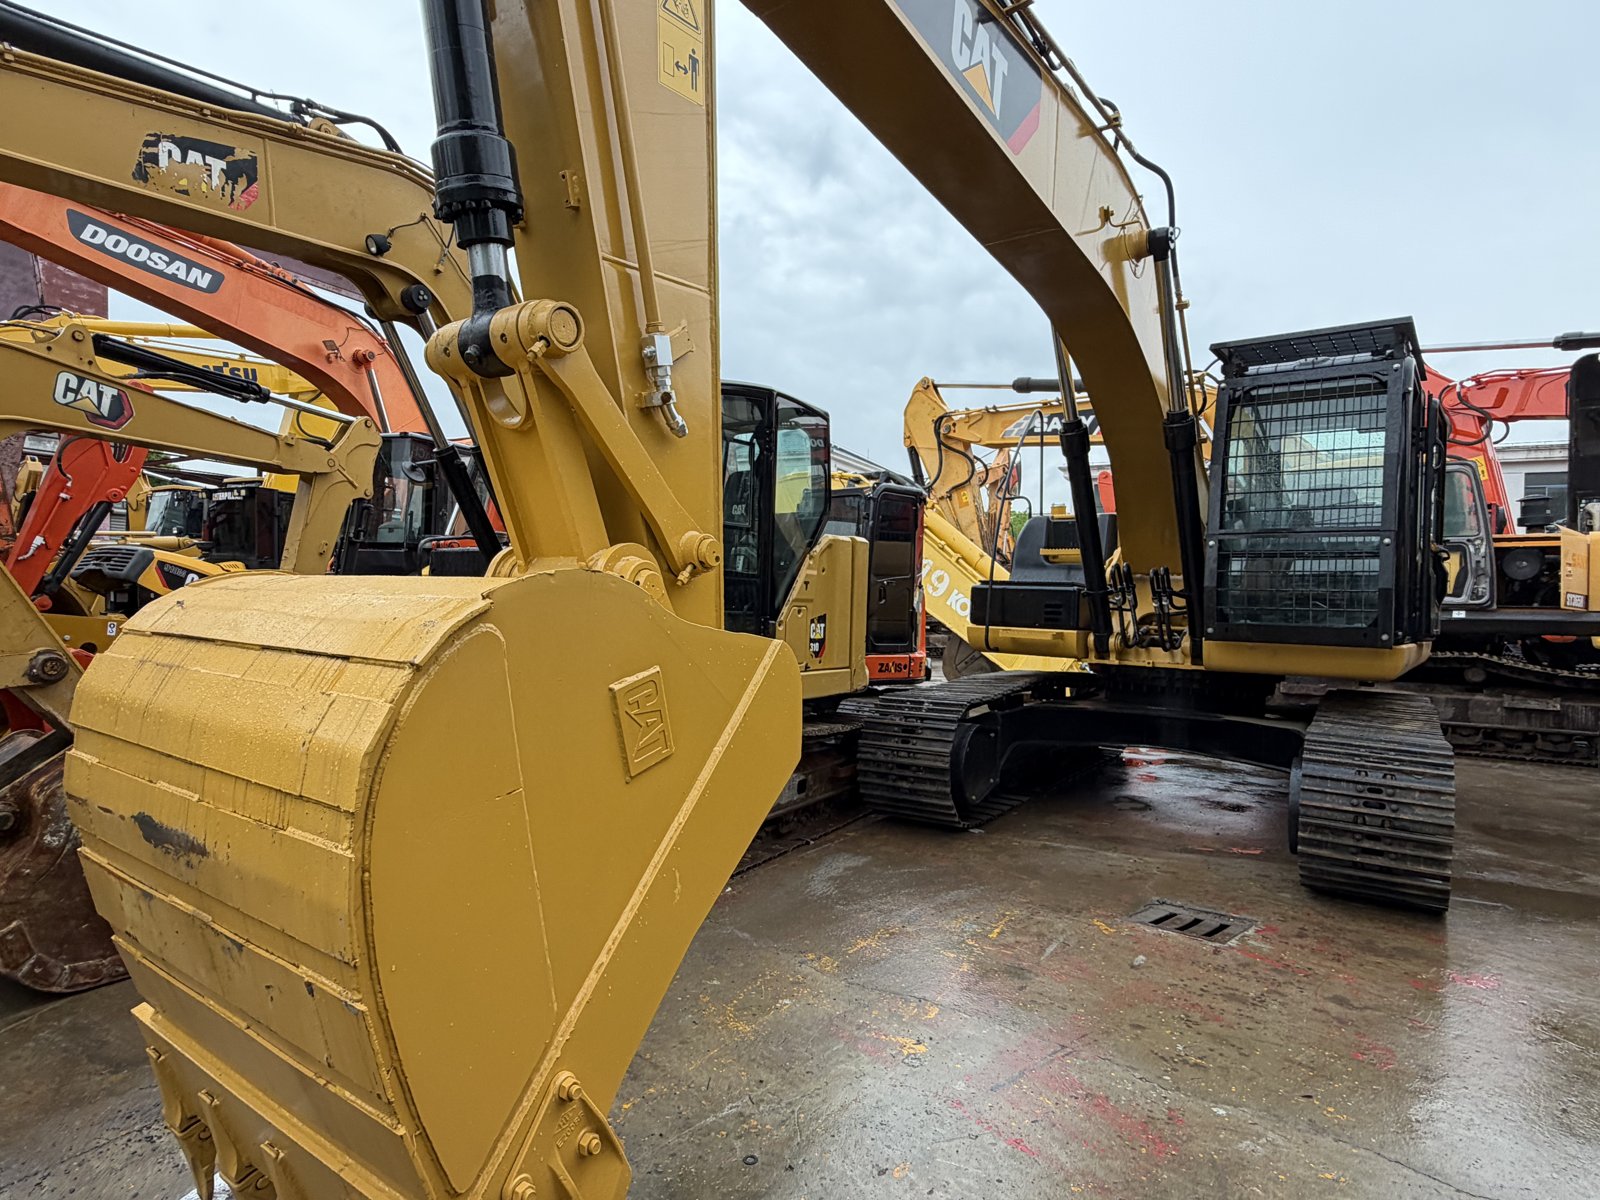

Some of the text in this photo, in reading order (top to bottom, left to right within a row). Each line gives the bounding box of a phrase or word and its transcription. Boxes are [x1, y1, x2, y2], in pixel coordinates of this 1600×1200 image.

[951, 0, 1009, 120] CAT
[79, 223, 213, 289] DOOSAN
[54, 371, 119, 418] CAT
[1033, 415, 1096, 433] SAY
[809, 642, 820, 652] 310
[810, 623, 826, 639] CAT
[623, 679, 670, 763] CAT
